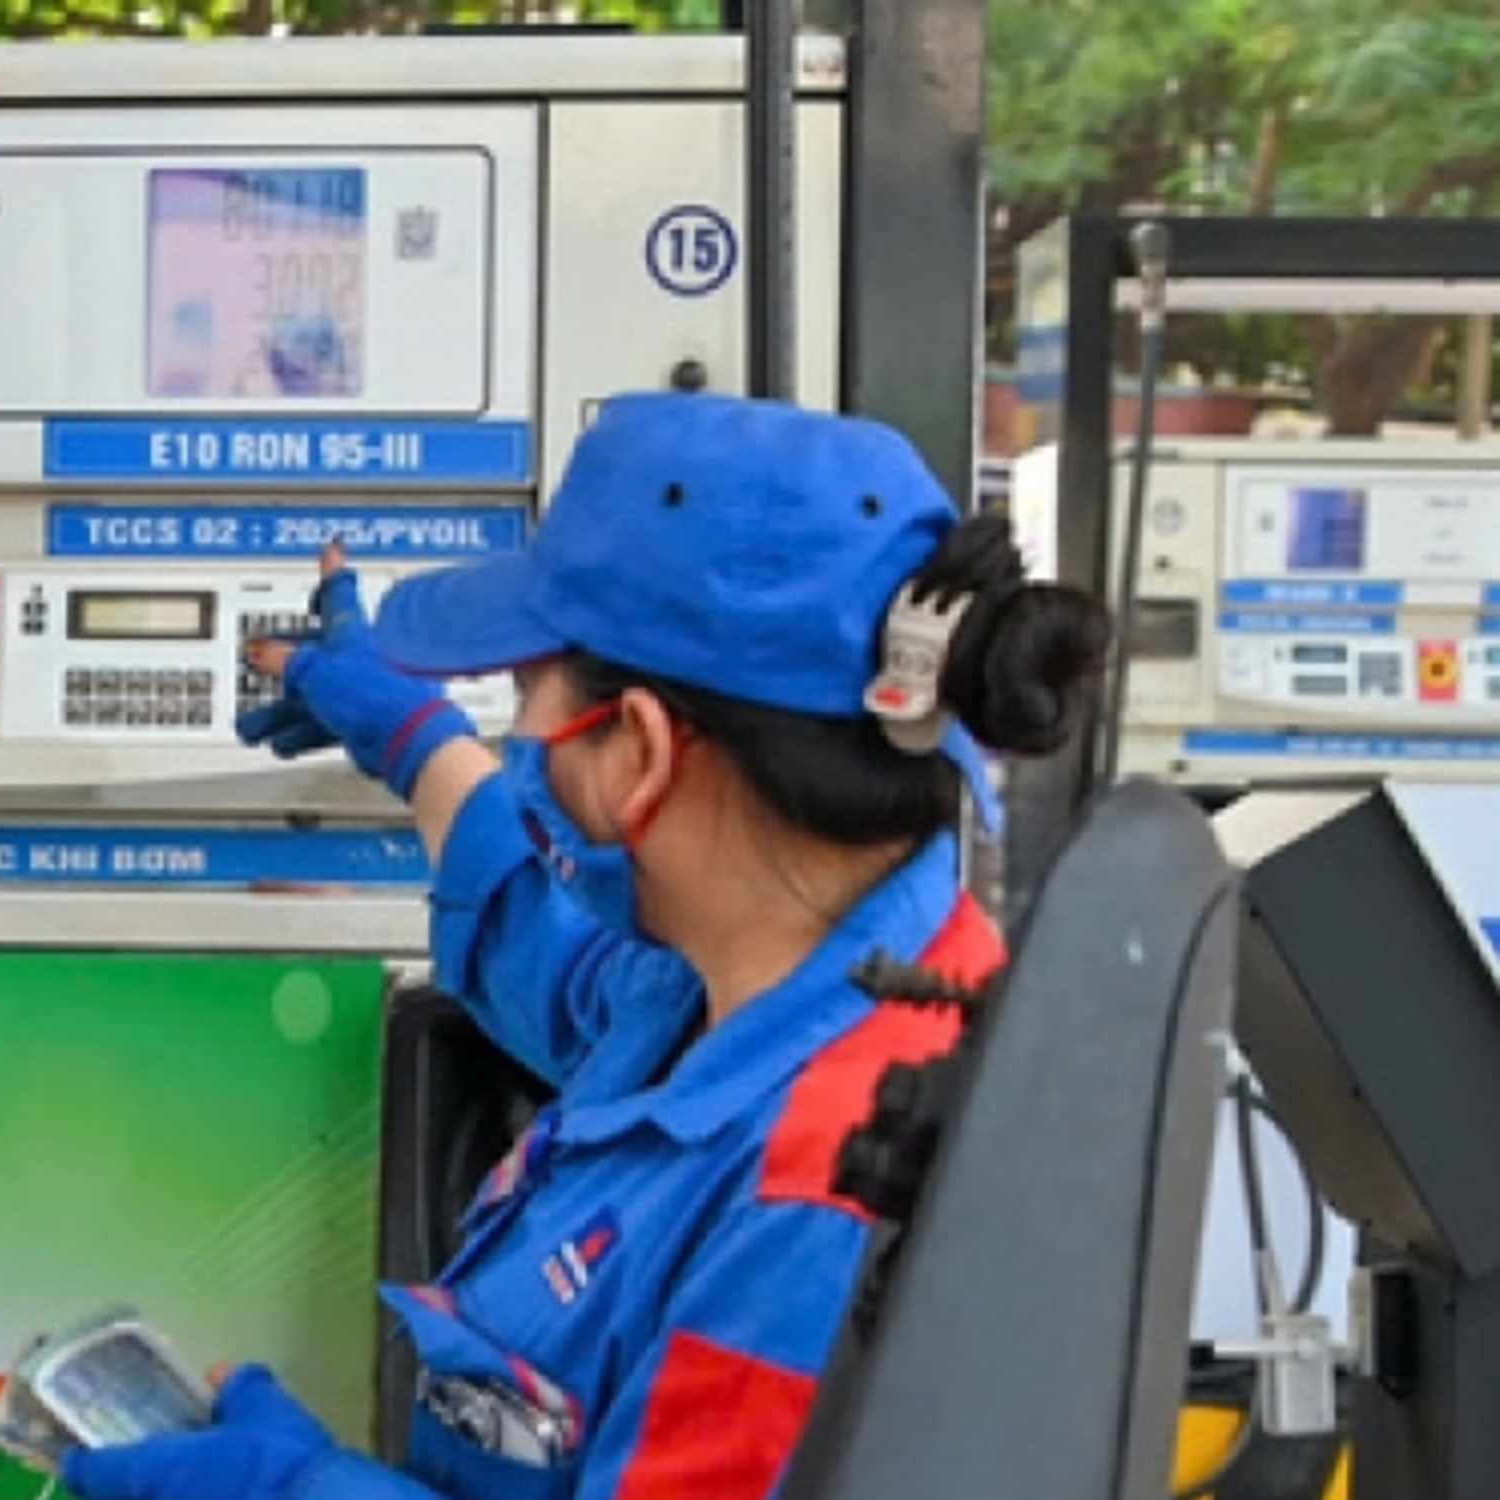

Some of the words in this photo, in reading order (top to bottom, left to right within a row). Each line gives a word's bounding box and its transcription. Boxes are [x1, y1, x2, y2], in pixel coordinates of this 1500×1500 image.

[666, 225, 719, 271] 15
[150, 432, 220, 469] E10
[230, 432, 310, 470] RON
[320, 432, 421, 470] 95-III
[87, 516, 180, 545] TCCS
[192, 517, 239, 546] 02
[29, 843, 98, 870] KHI
[112, 845, 207, 874] BƠM
